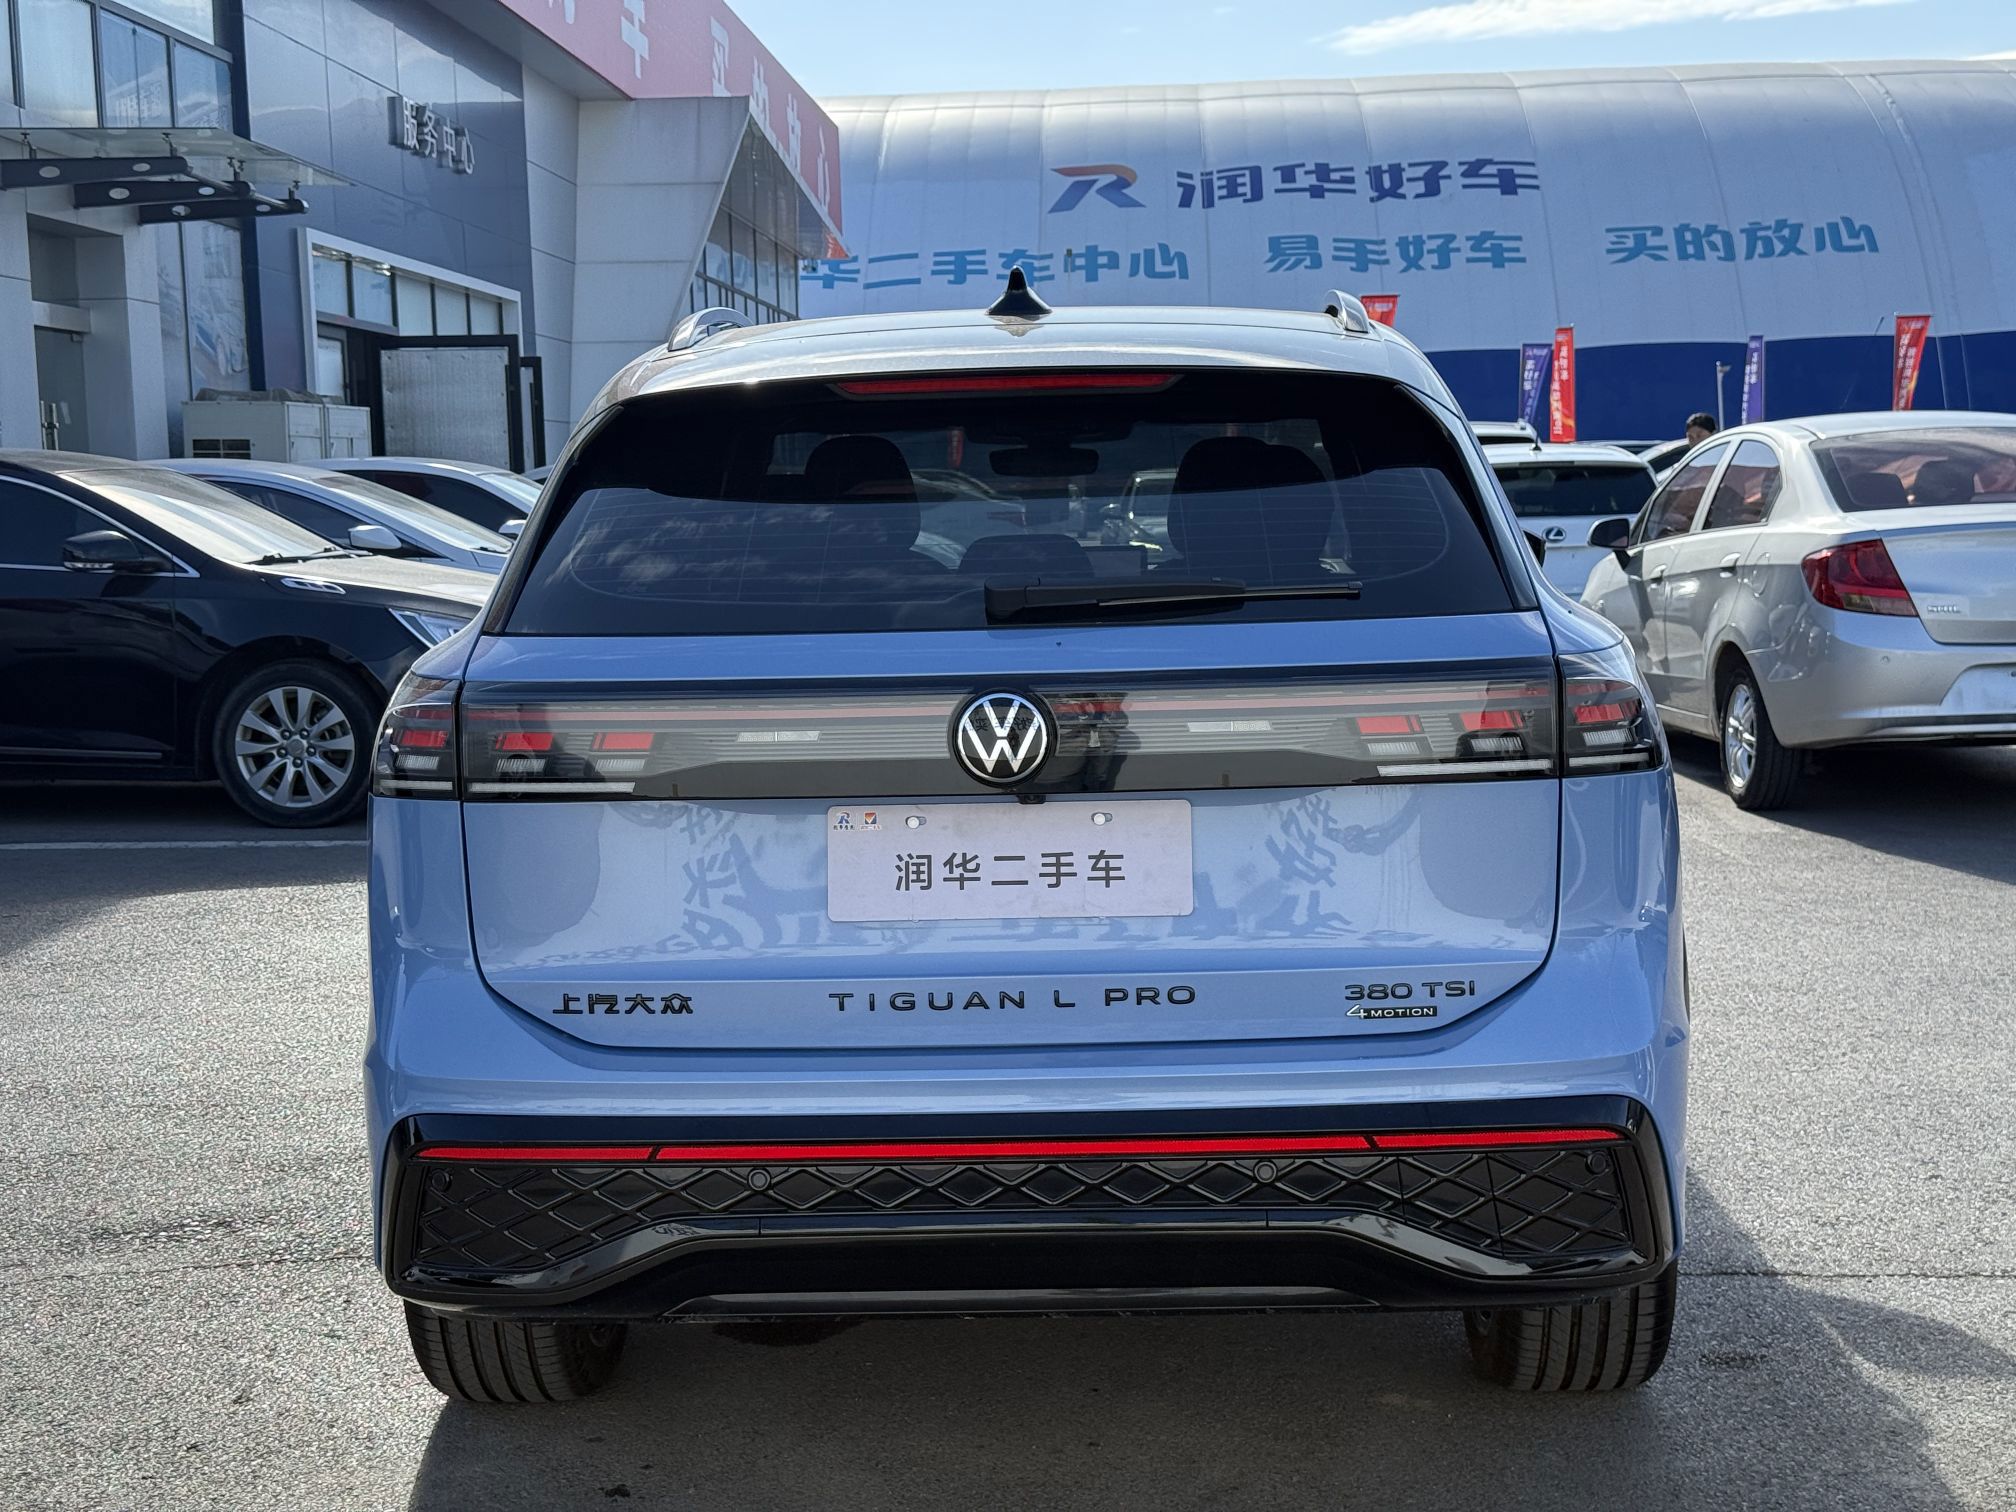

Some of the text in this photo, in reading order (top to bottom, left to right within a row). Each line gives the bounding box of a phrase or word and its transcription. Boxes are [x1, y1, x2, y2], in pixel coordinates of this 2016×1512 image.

[402, 97, 475, 174] 服务中心
[1176, 158, 1540, 209] 润华好车
[1264, 231, 1527, 273] 易手好车
[1604, 215, 1879, 264] 买的放心
[894, 849, 1126, 891] 润华二手车
[552, 993, 694, 1014] 上汽大众
[828, 985, 1196, 1012] TIGUAN L PRO
[1344, 980, 1476, 1001] 380 TSI
[1346, 1003, 1434, 1019] 4MOTION
